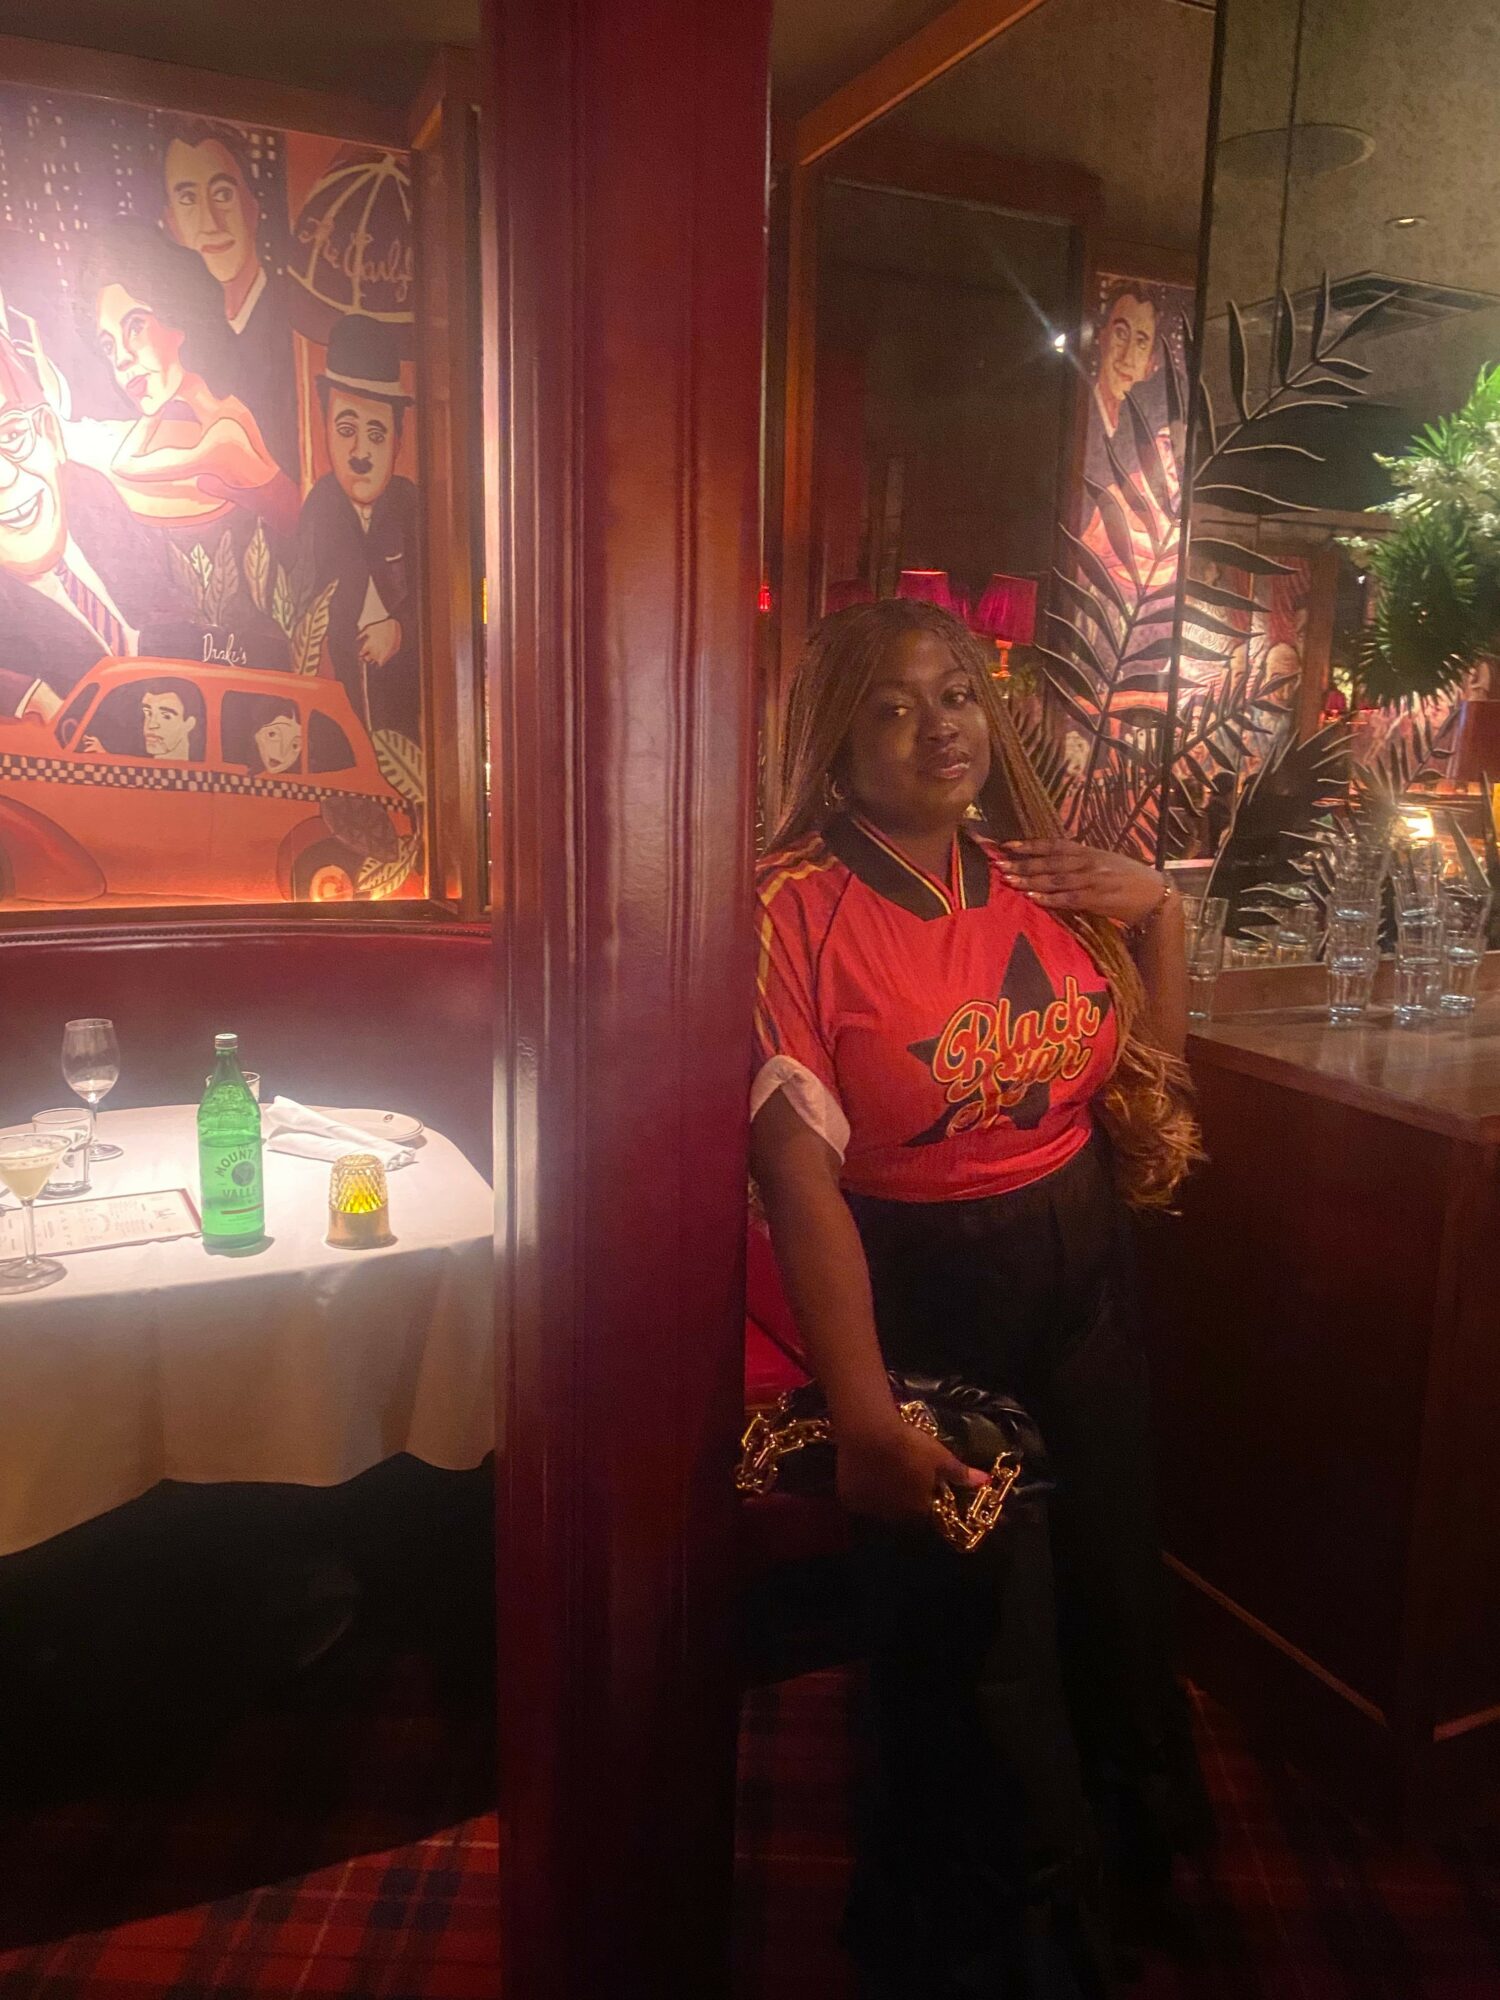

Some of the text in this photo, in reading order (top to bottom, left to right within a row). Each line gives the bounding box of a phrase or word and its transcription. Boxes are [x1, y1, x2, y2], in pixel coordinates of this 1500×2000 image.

[202, 633, 247, 667] Drake's
[933, 975, 1100, 1101] Black
[223, 1186, 258, 1200] VALLE
